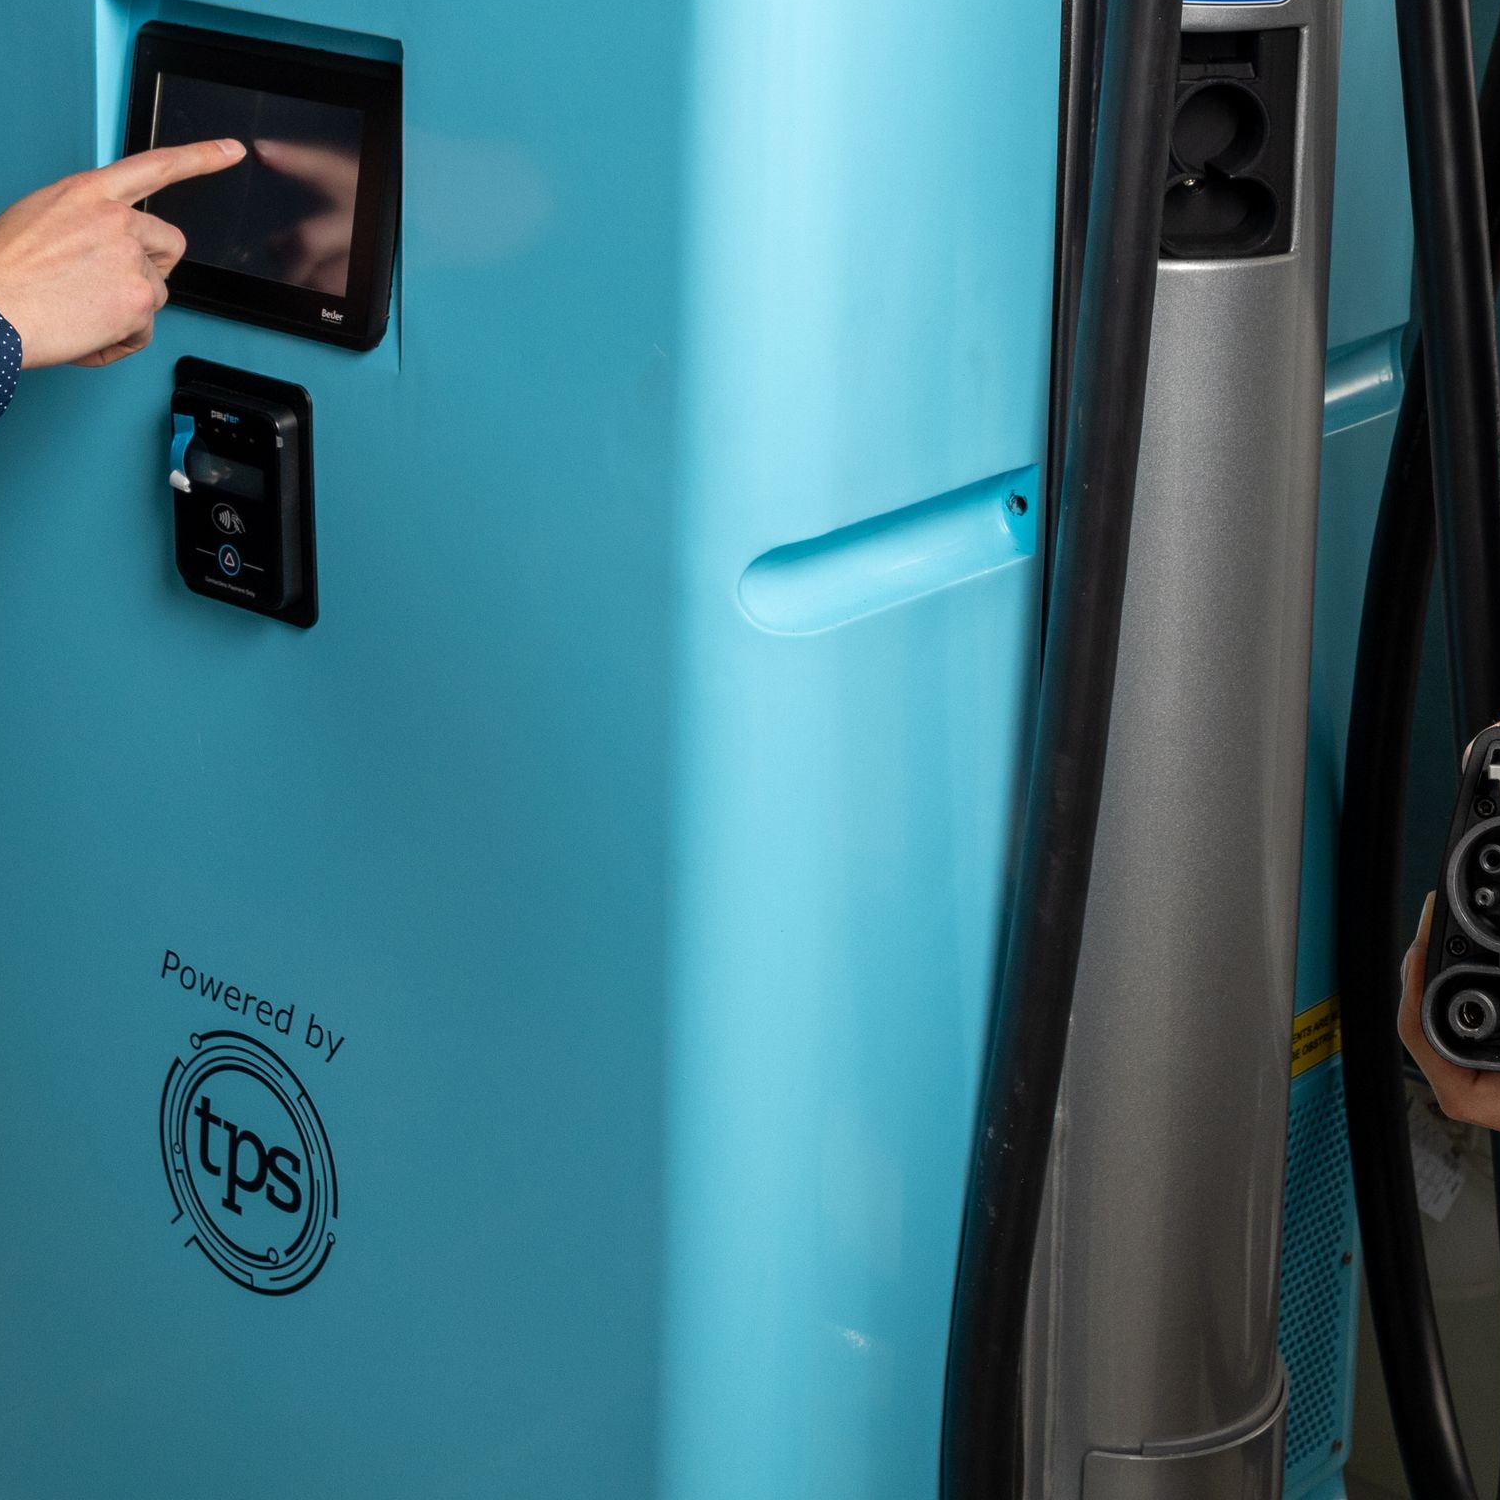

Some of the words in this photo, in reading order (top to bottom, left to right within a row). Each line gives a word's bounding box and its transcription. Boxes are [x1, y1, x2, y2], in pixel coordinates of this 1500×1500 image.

[161, 949, 295, 1035] Powered
[305, 1013, 345, 1063] by
[1292, 1025, 1311, 1045] ENTS
[194, 1095, 303, 1216] tps
